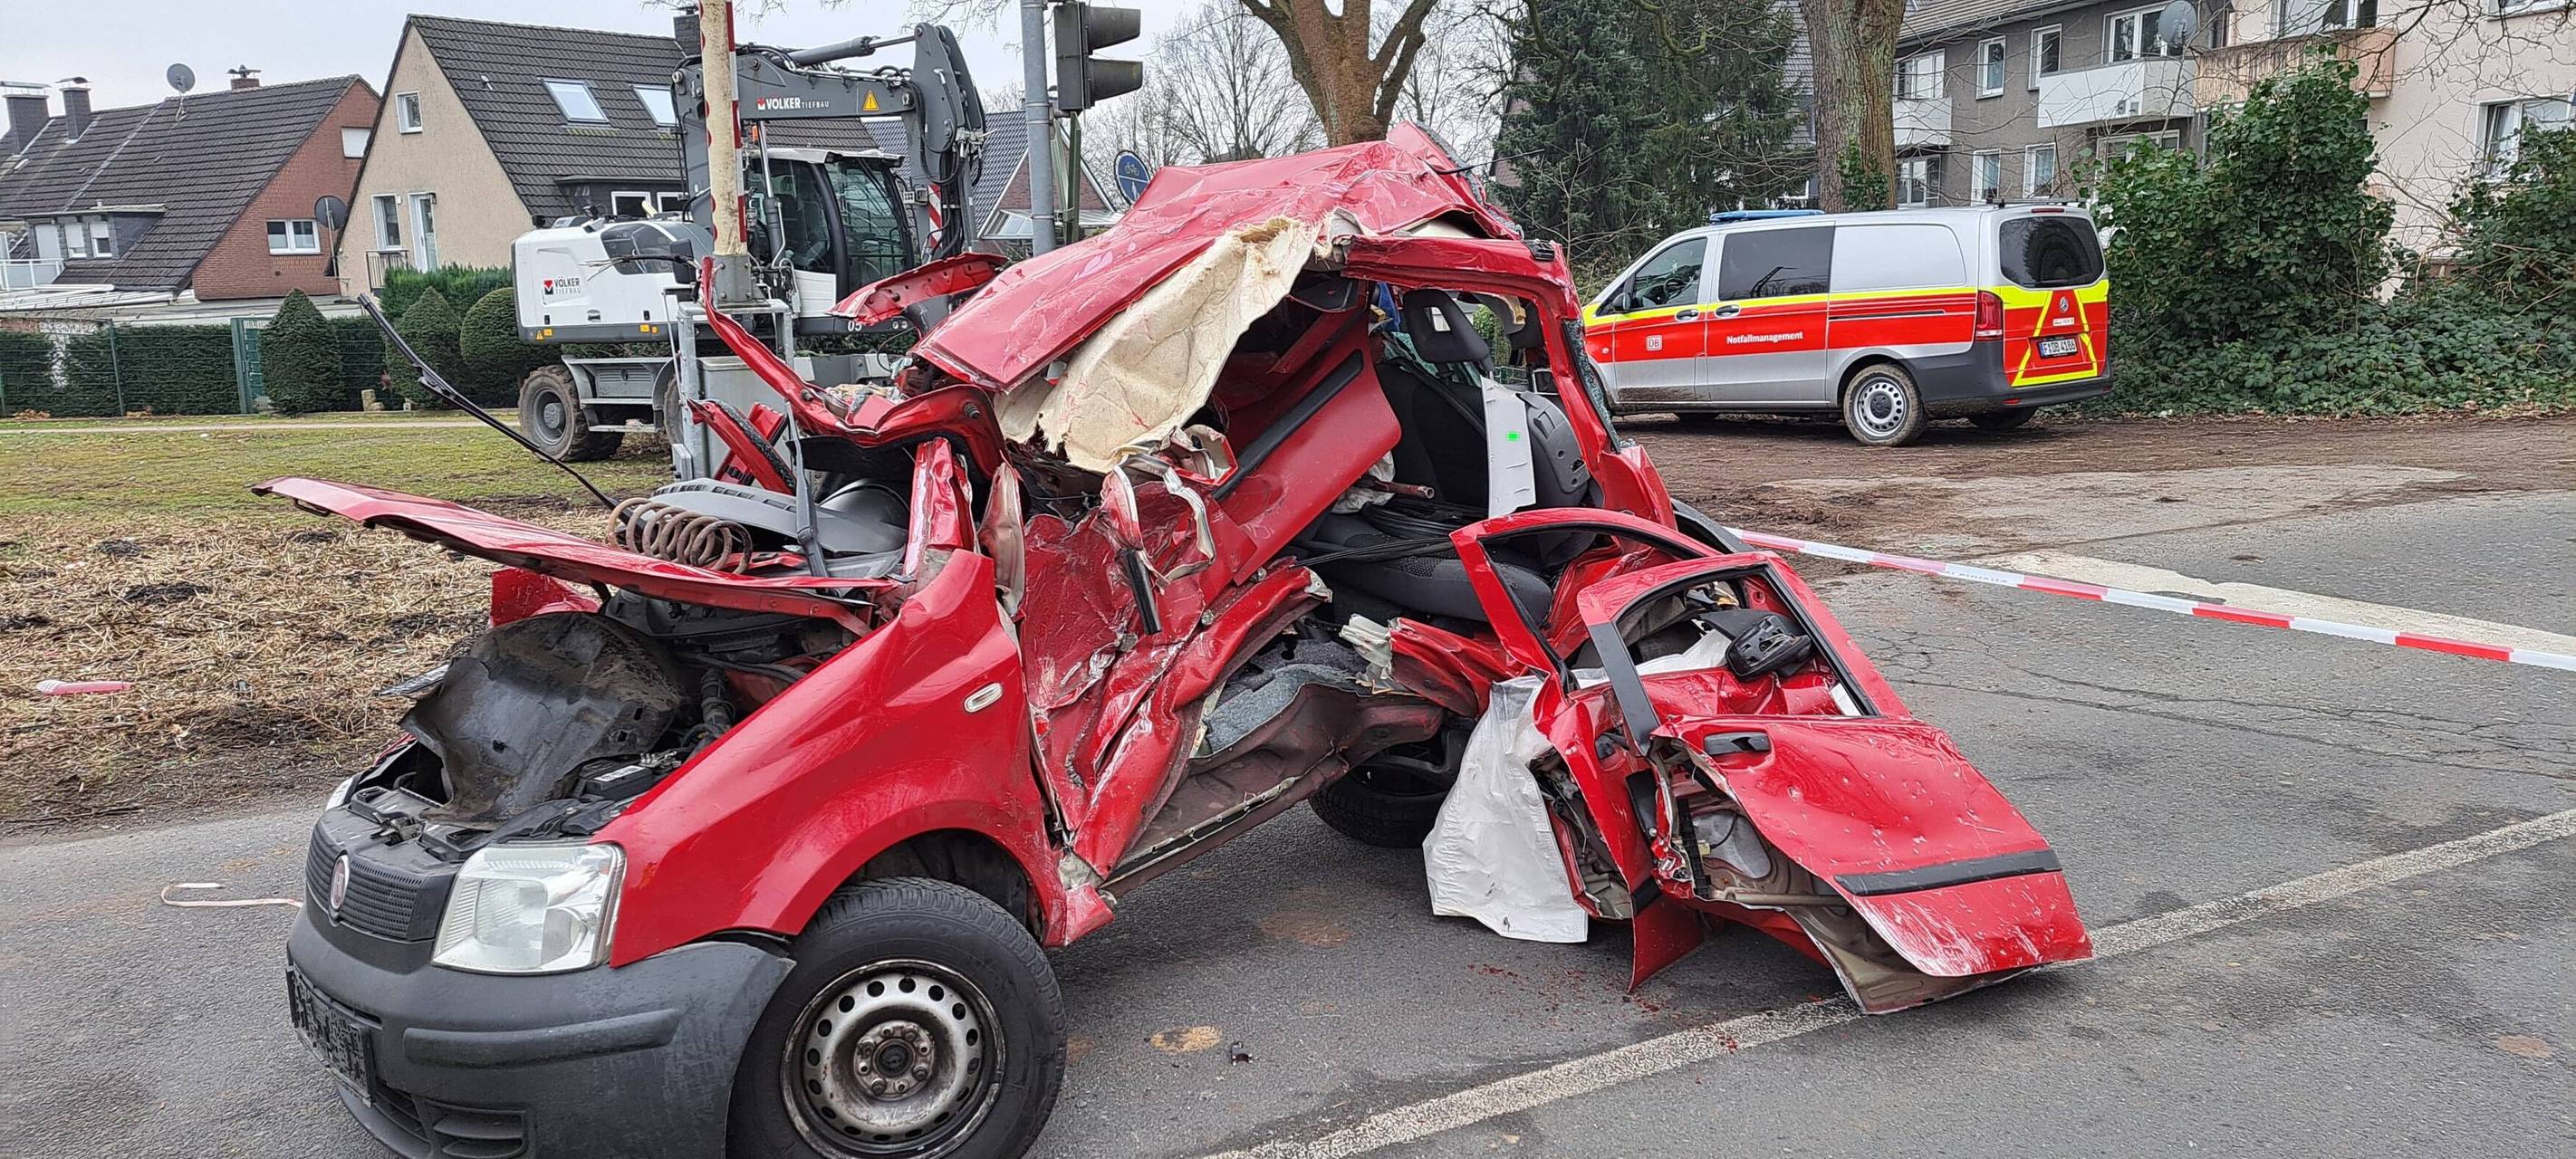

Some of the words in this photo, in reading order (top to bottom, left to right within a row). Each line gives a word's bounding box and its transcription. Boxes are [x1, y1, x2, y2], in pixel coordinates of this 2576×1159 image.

[802, 101, 829, 109] TIEFBAU
[1726, 331, 1803, 343] Notfallmanagement
[1648, 339, 1660, 348] DB
